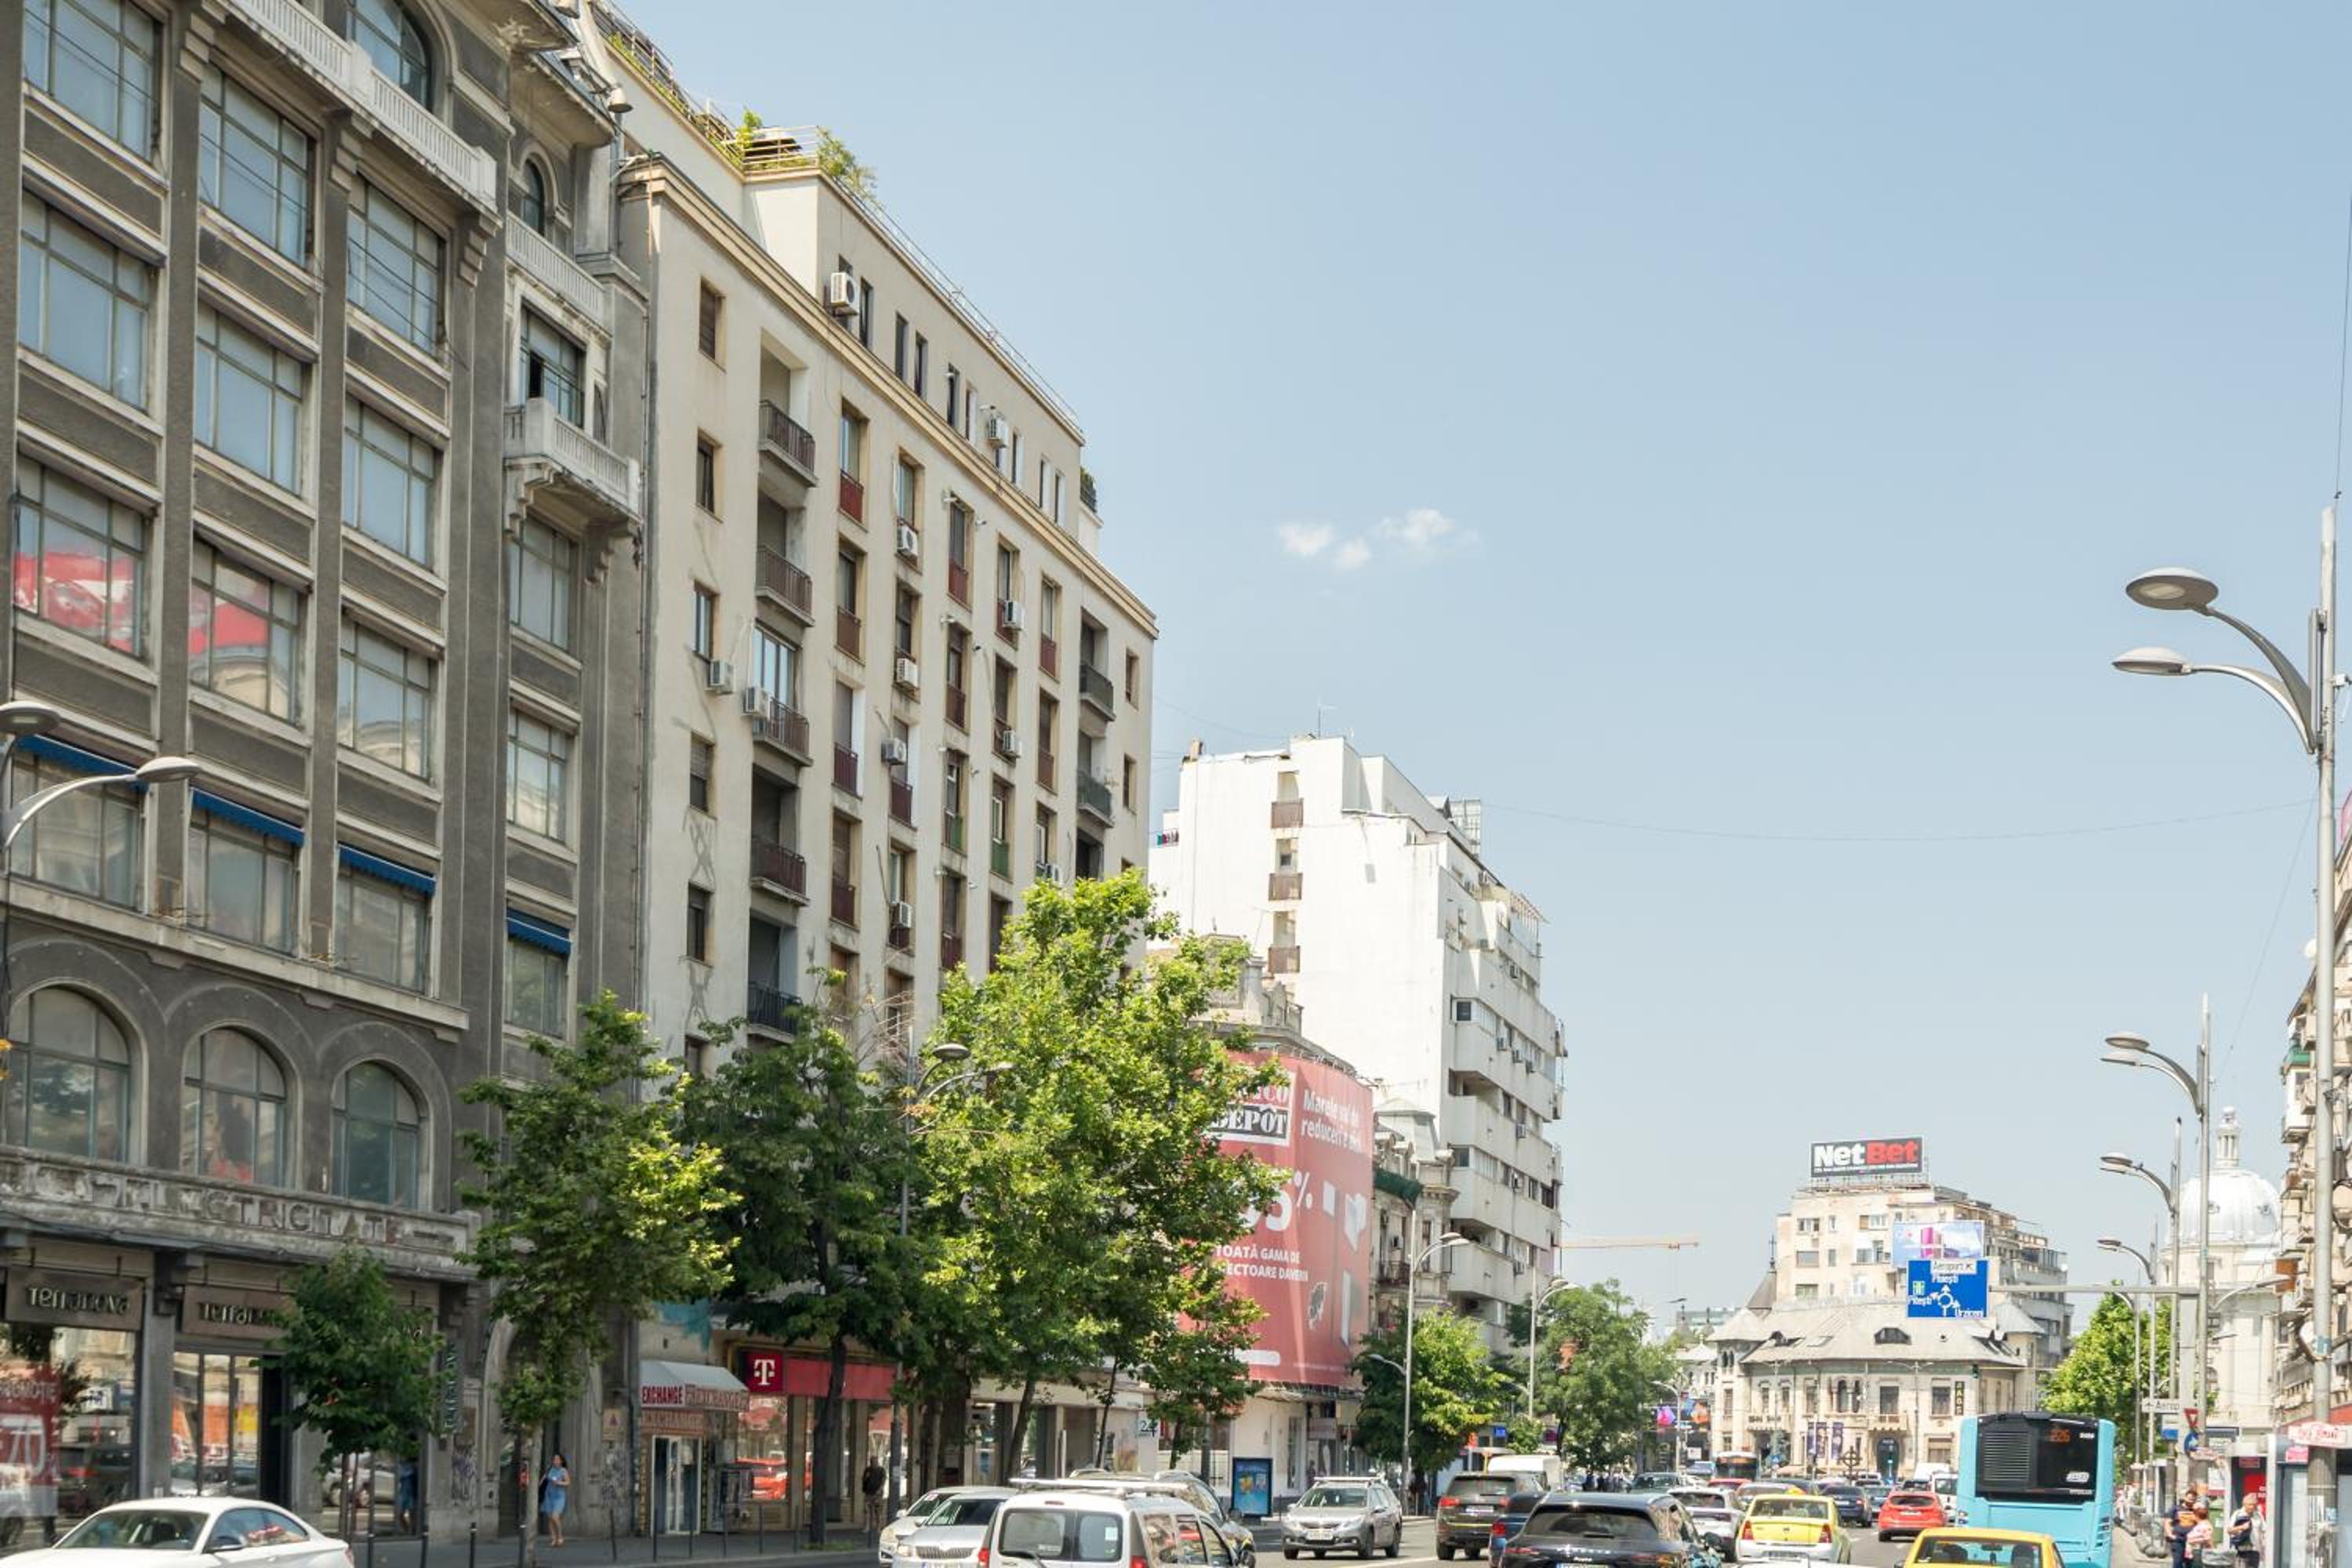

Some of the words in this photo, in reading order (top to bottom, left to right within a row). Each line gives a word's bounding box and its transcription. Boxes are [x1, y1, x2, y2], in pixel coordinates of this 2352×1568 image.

[1813, 1141, 1918, 1167] NetBet
[1217, 1243, 1257, 1260] TOATĂ
[1260, 1249, 1290, 1263] GAMA
[1290, 1251, 1301, 1265] DE
[1223, 1262, 1277, 1279] ECTOARE
[754, 1359, 775, 1386] T
[643, 1385, 684, 1404] EXCHANGE
